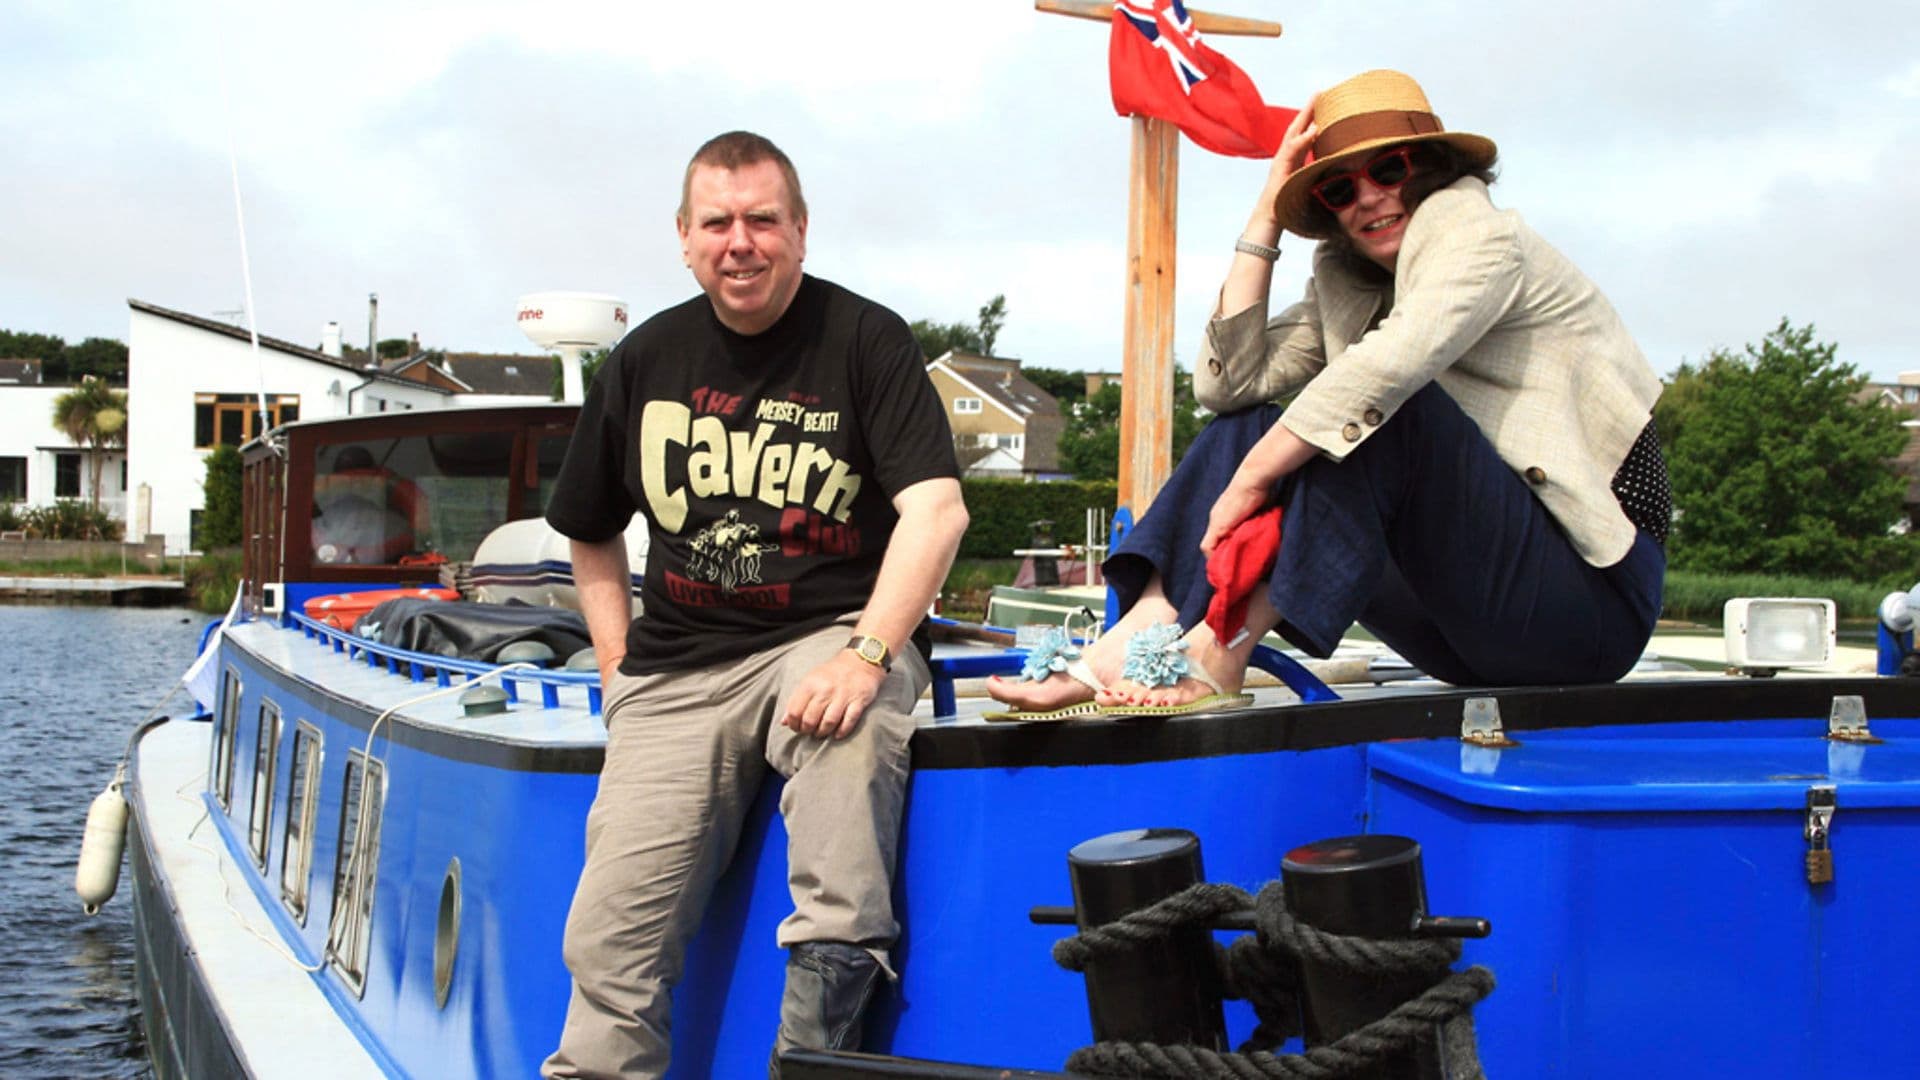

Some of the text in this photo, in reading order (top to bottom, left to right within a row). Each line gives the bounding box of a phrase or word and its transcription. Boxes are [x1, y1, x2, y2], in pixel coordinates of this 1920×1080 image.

[691, 386, 744, 415] THE
[755, 399, 840, 432] MERSEY BEAT!
[640, 400, 862, 535] Cavern
[779, 507, 861, 557] Club
